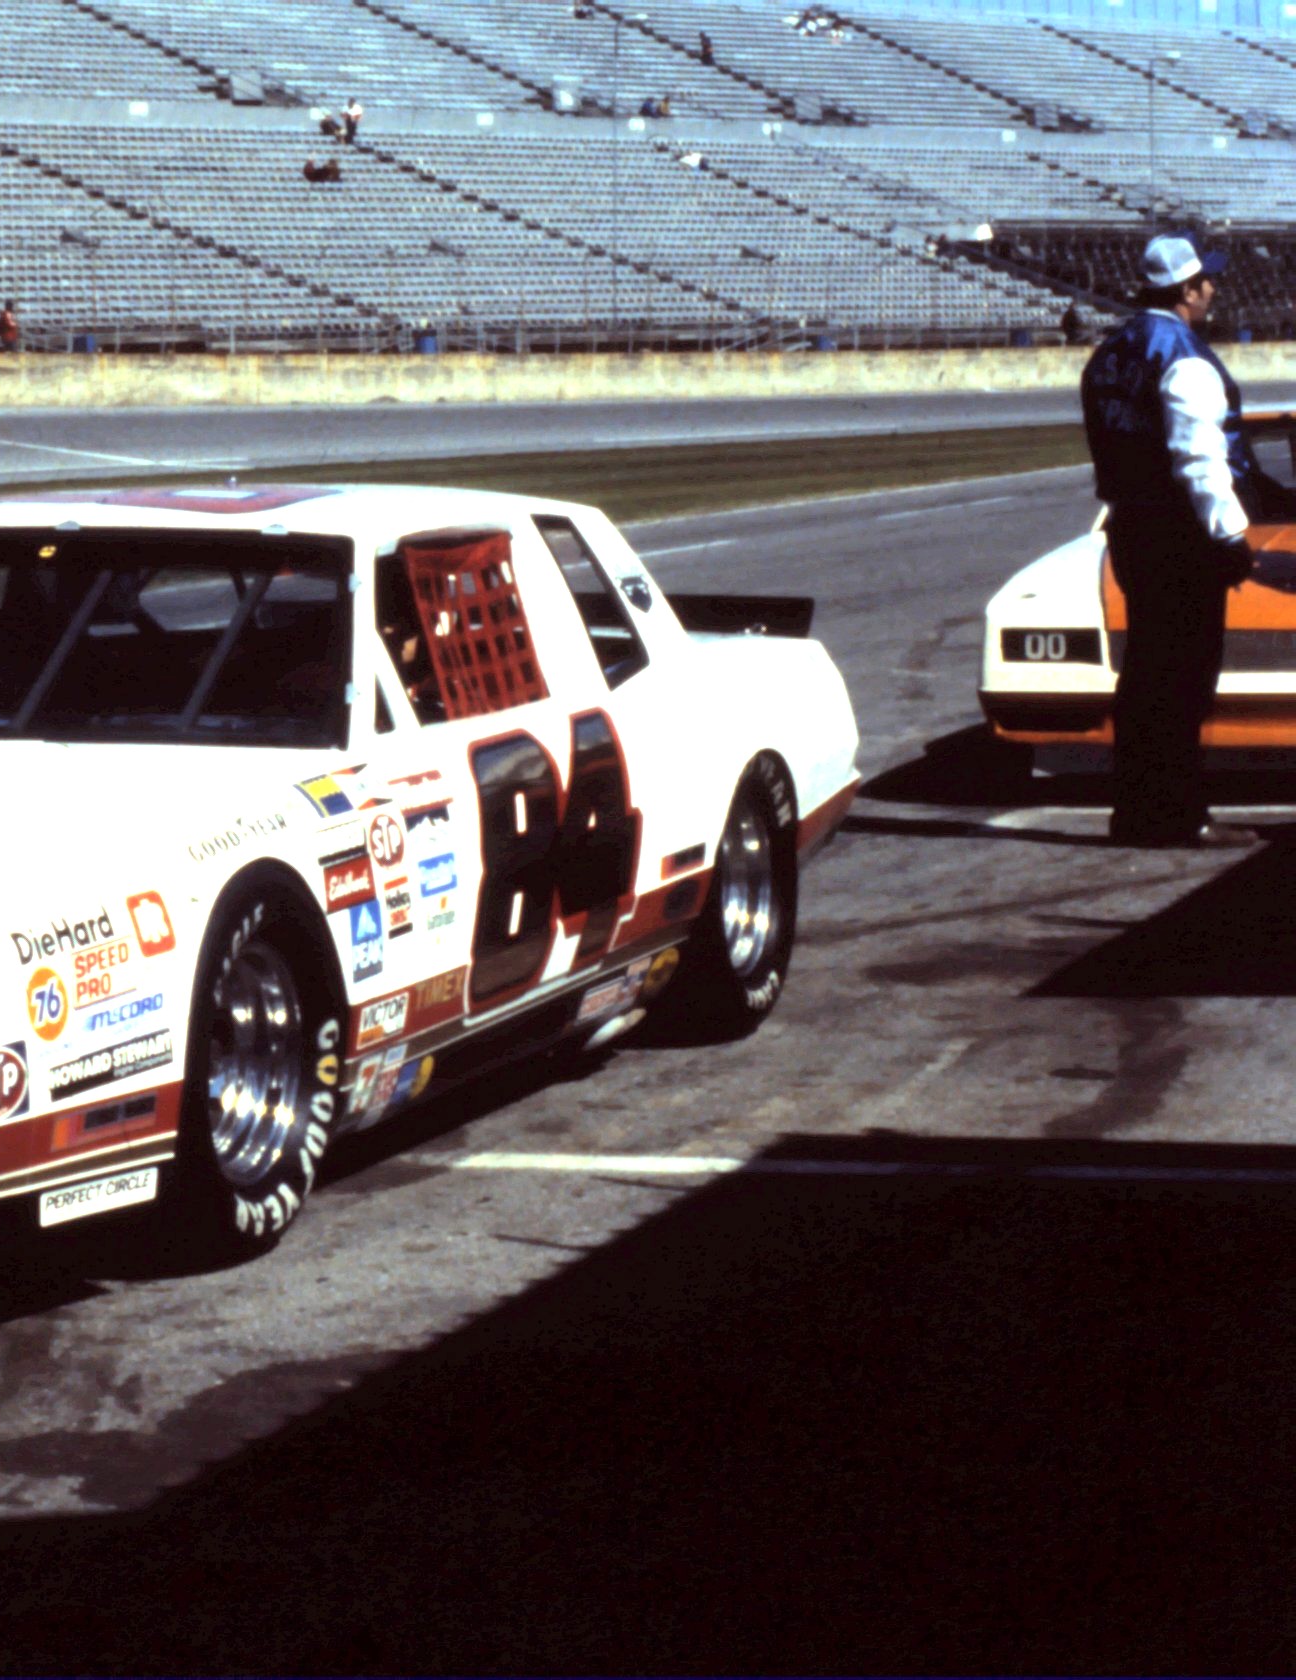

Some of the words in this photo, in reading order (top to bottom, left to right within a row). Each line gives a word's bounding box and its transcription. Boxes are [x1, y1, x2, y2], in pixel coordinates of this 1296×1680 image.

[1025, 633, 1066, 660] 00
[371, 815, 403, 862] STP
[468, 706, 643, 1003] 84
[11, 905, 114, 965] DieHard
[74, 943, 129, 978] SPEED
[35, 982, 61, 1022] 76
[76, 973, 111, 1003] PRO
[361, 995, 406, 1027] VICTOR
[49, 1052, 113, 1090] HOWARD
[113, 1034, 173, 1069] STEWART
[45, 1184, 102, 1211] PERFECT
[106, 1171, 151, 1196] CIRCLE
